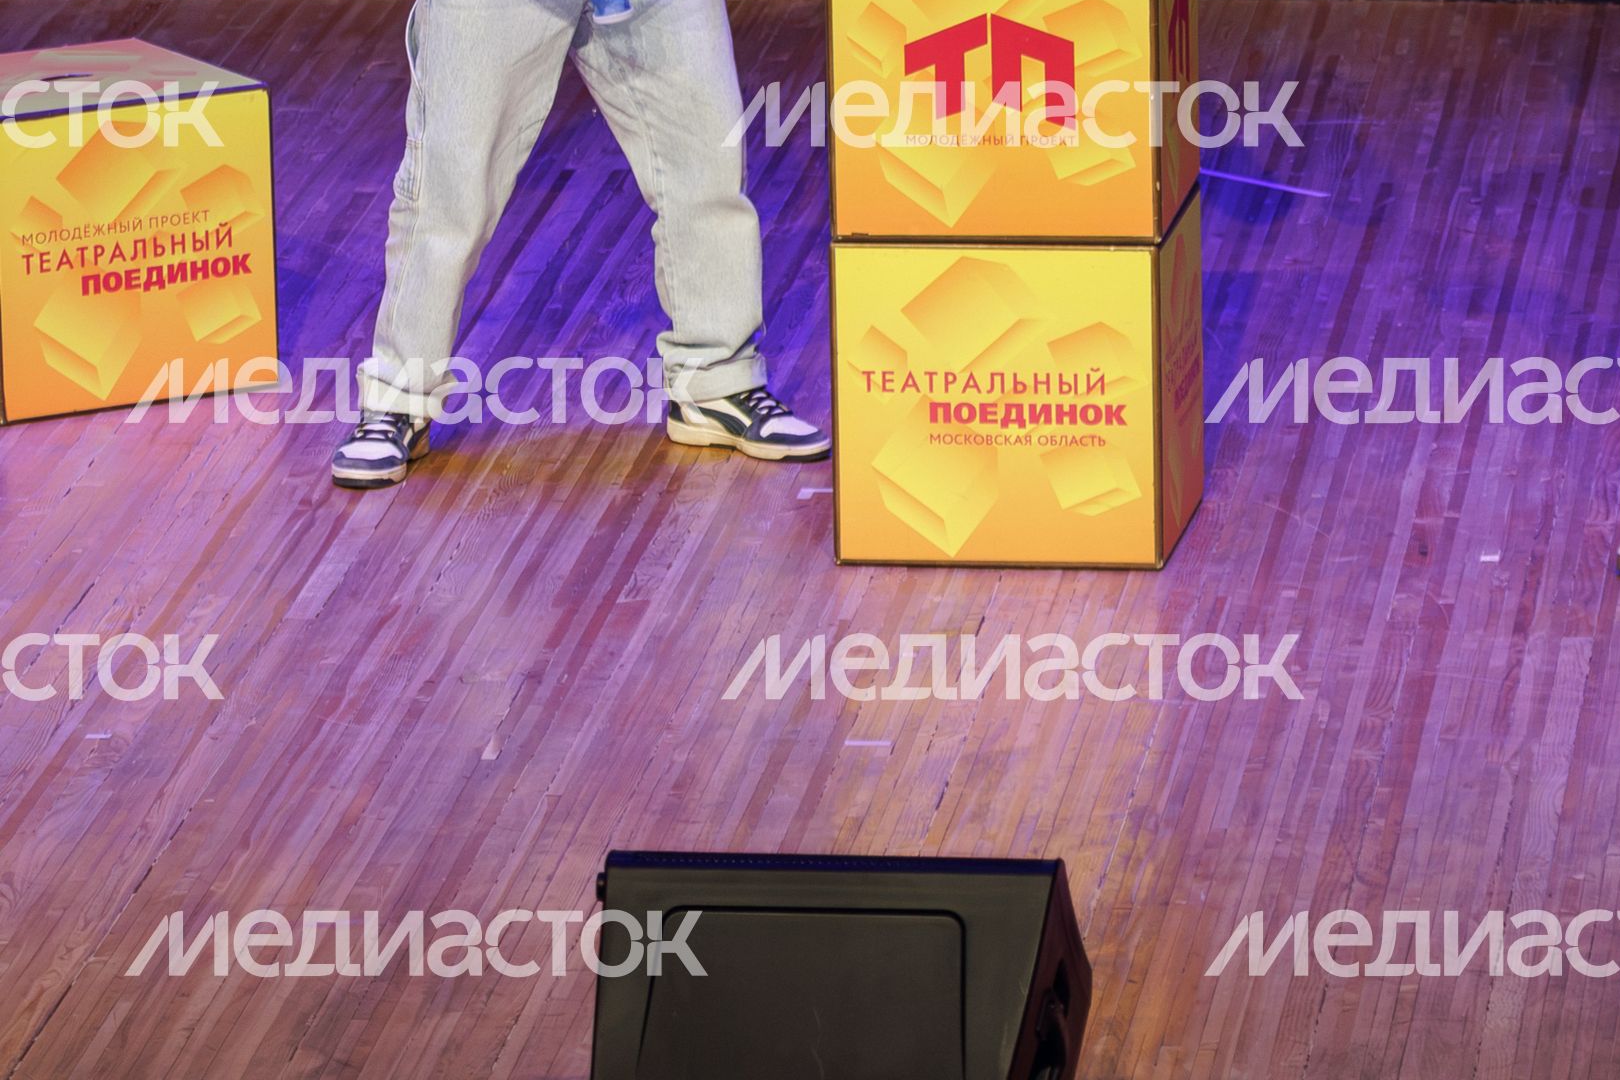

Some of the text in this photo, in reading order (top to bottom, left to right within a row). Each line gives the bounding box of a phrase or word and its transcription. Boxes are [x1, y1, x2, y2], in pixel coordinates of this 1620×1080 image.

[904, 13, 1076, 131] ТП
[148, 210, 210, 229] ПРОЕКТ
[21, 222, 233, 275] ТЕАТРАЛЬНЫЙ
[81, 253, 252, 296] ПОЕДИНОК
[862, 367, 1106, 395] ТЕАТРАЛЬНЫЙ
[929, 402, 1127, 429] ПОЕДИНОК
[929, 434, 1106, 447] МОСКОВСКАЯ ОБЛАСТЬ
